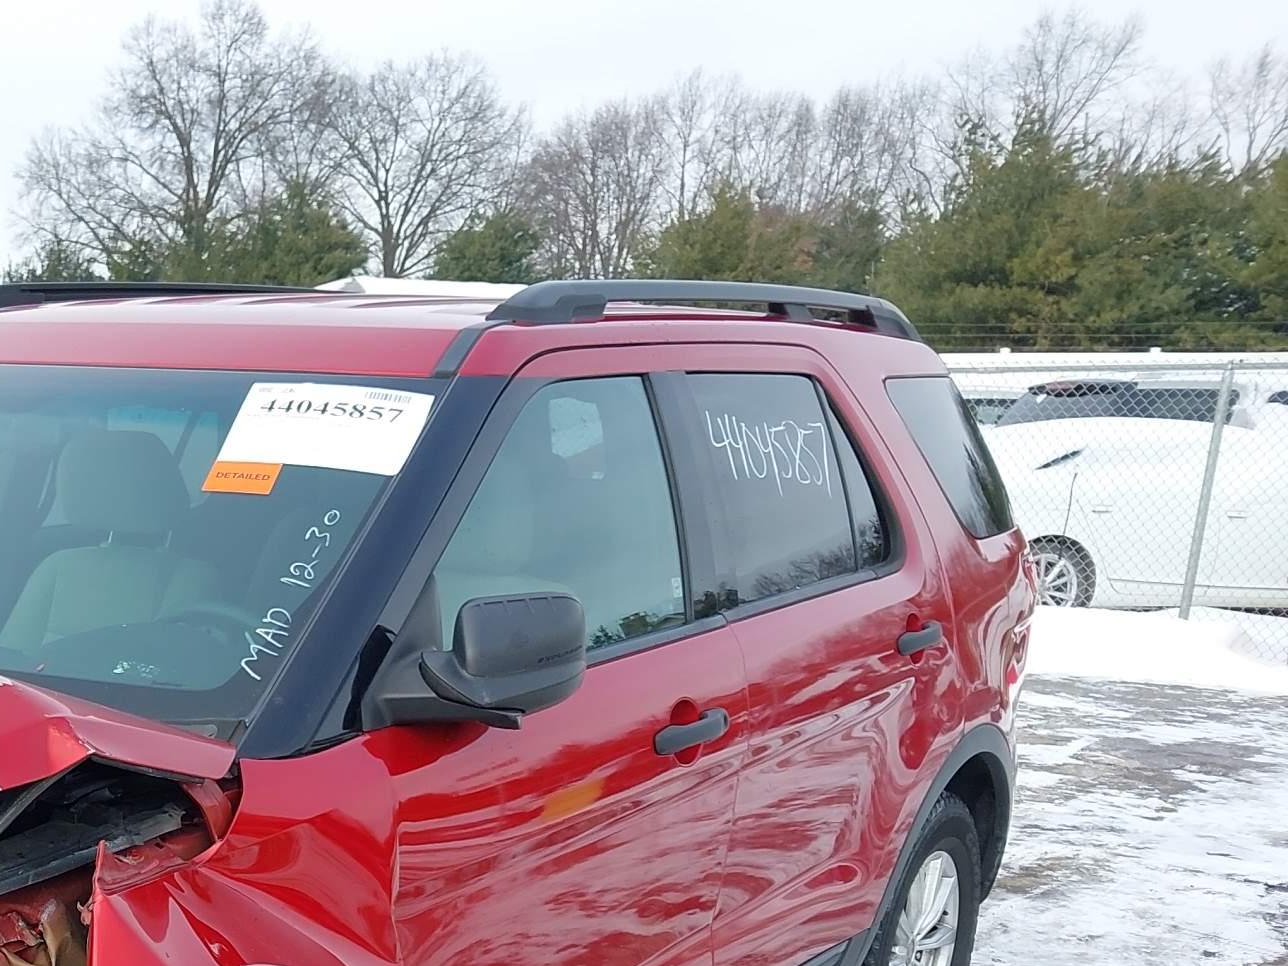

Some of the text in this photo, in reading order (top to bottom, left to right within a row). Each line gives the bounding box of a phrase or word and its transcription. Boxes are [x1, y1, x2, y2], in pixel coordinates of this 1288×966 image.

[260, 398, 404, 423] 44045857
[215, 471, 271, 482] DETAILED
[705, 410, 831, 497] 44045857
[240, 509, 340, 681] MAD 12-30
